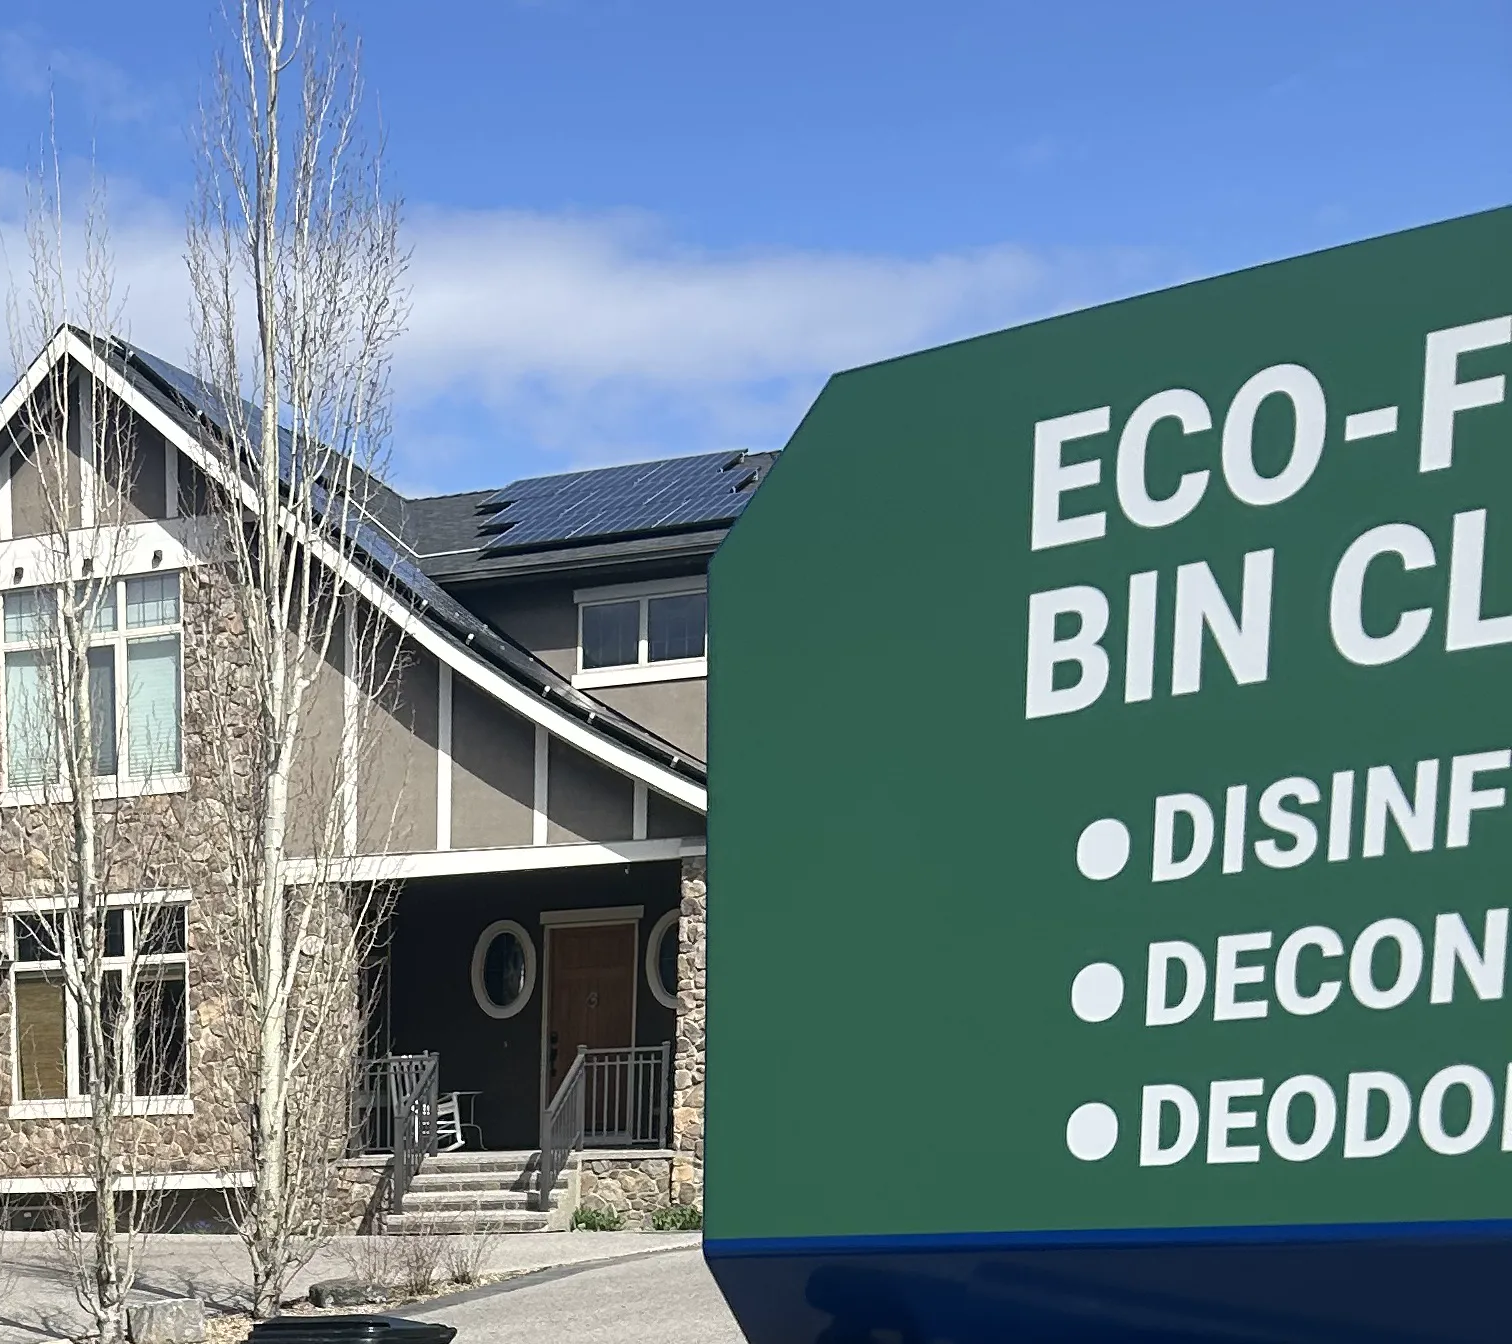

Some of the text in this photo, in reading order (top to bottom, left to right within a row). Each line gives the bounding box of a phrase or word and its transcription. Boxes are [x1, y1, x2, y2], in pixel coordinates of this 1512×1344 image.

[1031, 314, 1512, 551] ECO-F
[1025, 508, 1512, 719] BIN CL
[1152, 749, 1512, 882] DISINF
[1145, 907, 1510, 1026] DECON
[1139, 1061, 1512, 1167] DEODO
